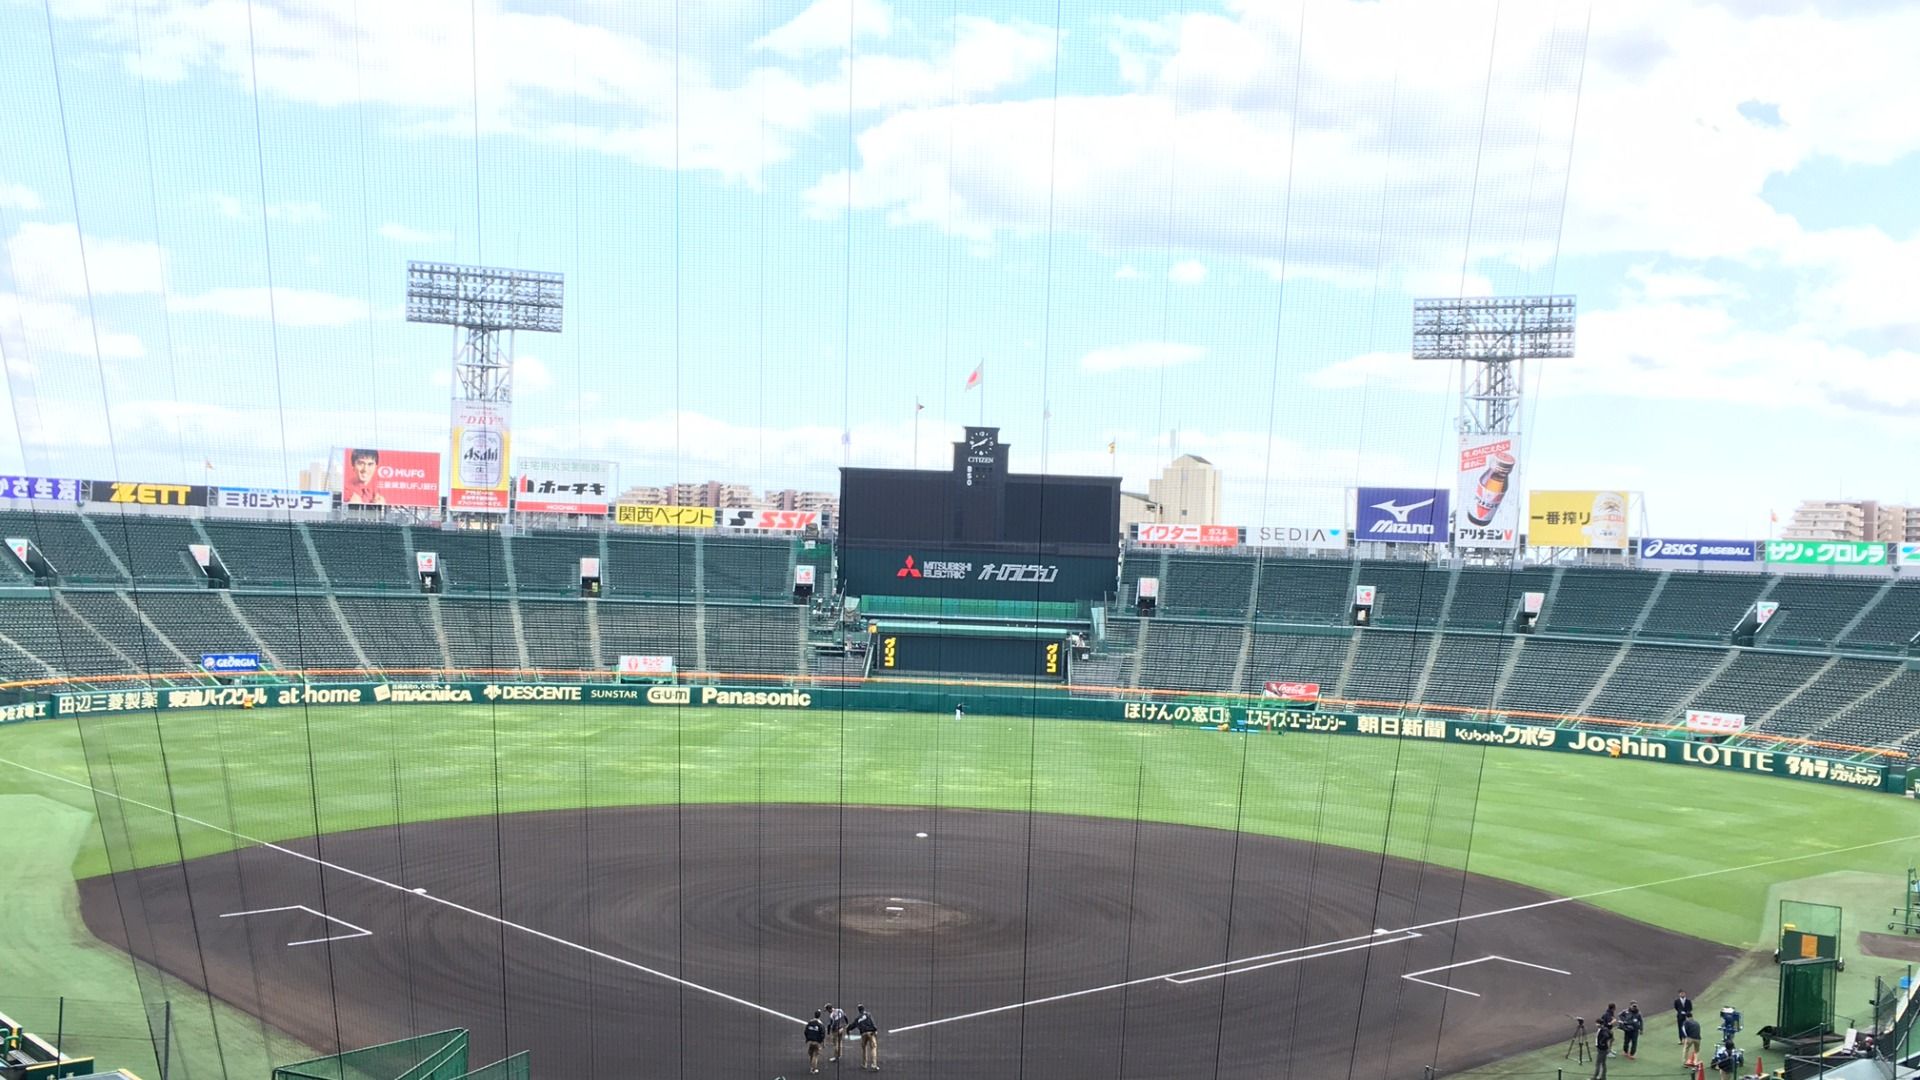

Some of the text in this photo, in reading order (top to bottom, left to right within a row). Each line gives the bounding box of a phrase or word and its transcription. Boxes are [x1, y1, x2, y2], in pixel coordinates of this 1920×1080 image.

[464, 447, 498, 462] Asahi
[394, 468, 425, 479] MUFG
[110, 482, 191, 505] ZETT
[538, 480, 605, 496] ホーチキ
[226, 492, 323, 509] 三和シャッター
[619, 506, 712, 525] 関西ペイント
[758, 511, 816, 529] SSK
[1531, 511, 1591, 525] 一番搾り
[1141, 525, 1198, 540] イワタニ
[1459, 528, 1513, 541] アリナミンV
[1700, 546, 1751, 556] BASEBALL
[1769, 543, 1884, 563] サン・クロレラ
[923, 561, 972, 572] MITSUBISHI
[923, 569, 966, 580] ELECTRIC
[884, 637, 896, 667] グリコ
[1046, 643, 1058, 673] グリコ
[216, 655, 257, 668] GEORGIA
[168, 687, 268, 708] 東進ハイスクール
[278, 684, 362, 704] at home
[502, 686, 582, 700] DESCENTE
[591, 689, 637, 699] SUNSTAR
[702, 687, 811, 706] Panasonic
[59, 691, 158, 714] 田辺三菱製薬
[1124, 702, 1226, 723] ほけんの窓口
[1247, 709, 1347, 731] エスライズ・エージェンシー
[1357, 716, 1446, 739] 朝日新聞
[1455, 725, 1556, 747] Kubota クボタ
[1568, 732, 1666, 760] Joshin
[1683, 743, 1774, 772] LOTTE
[1785, 755, 1829, 779] タカラ
[1834, 763, 1878, 774] ホーロー
[1830, 769, 1881, 787] システムキッチン
